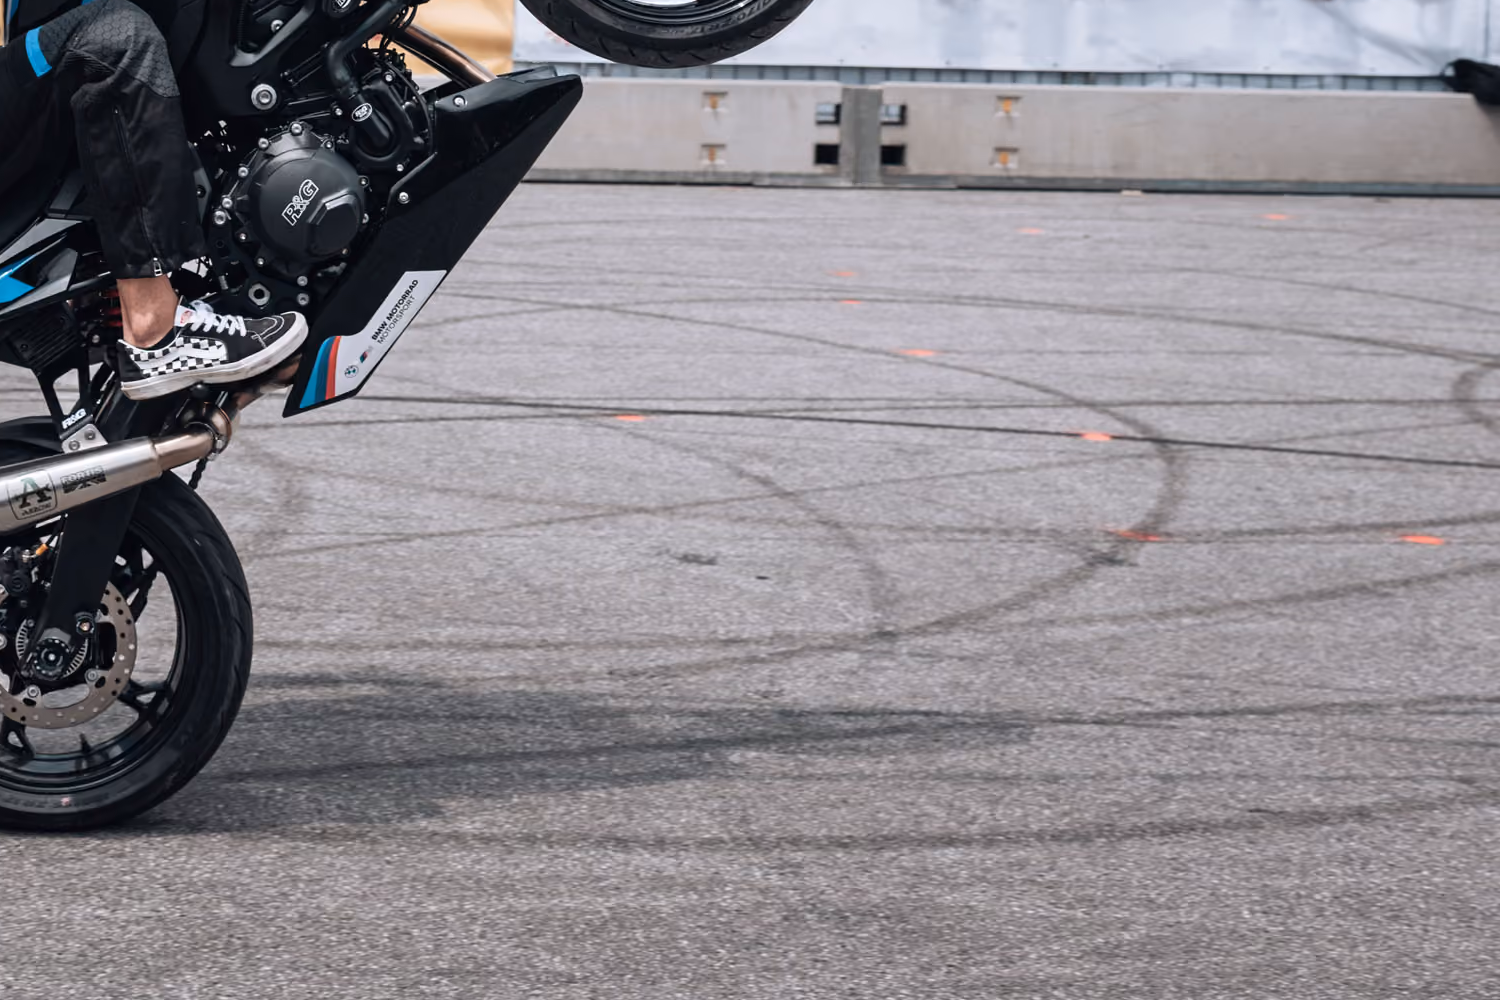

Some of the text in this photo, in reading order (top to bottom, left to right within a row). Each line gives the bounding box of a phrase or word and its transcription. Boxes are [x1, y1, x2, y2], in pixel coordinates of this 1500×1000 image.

[281, 179, 320, 227] R&G
[371, 279, 419, 341] BMW MOTORRAD
[377, 295, 416, 344] MOTORSPORT
[62, 408, 87, 430] R&G
